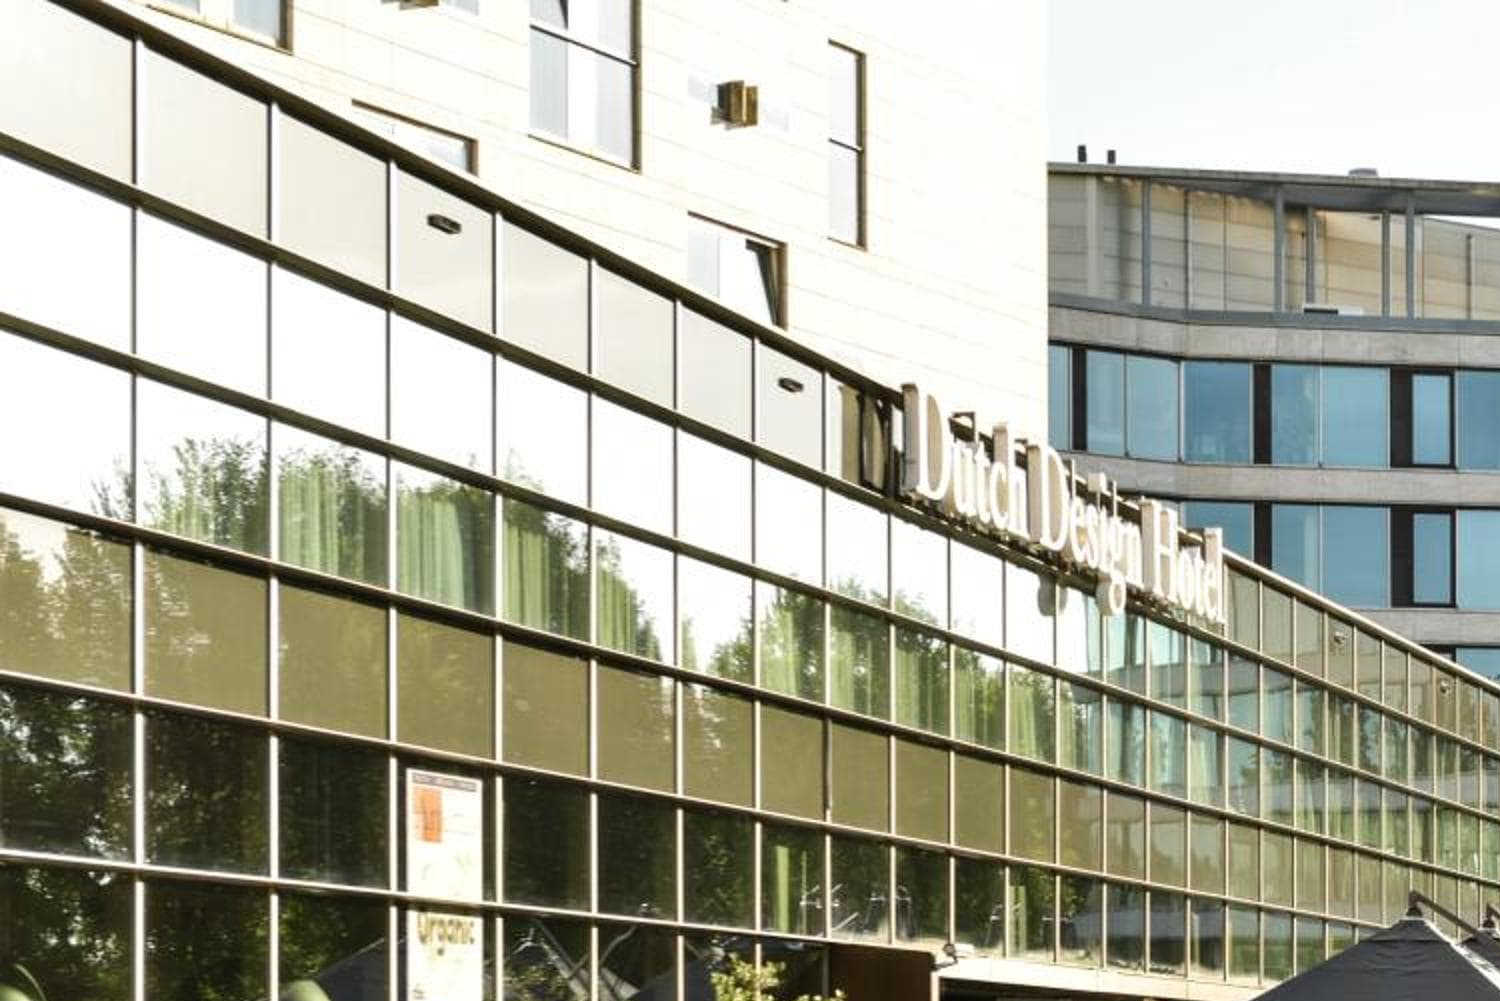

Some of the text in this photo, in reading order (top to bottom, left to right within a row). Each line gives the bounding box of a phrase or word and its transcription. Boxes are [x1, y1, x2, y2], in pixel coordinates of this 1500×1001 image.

[903, 383, 1224, 625] Dutch Design Hotel
